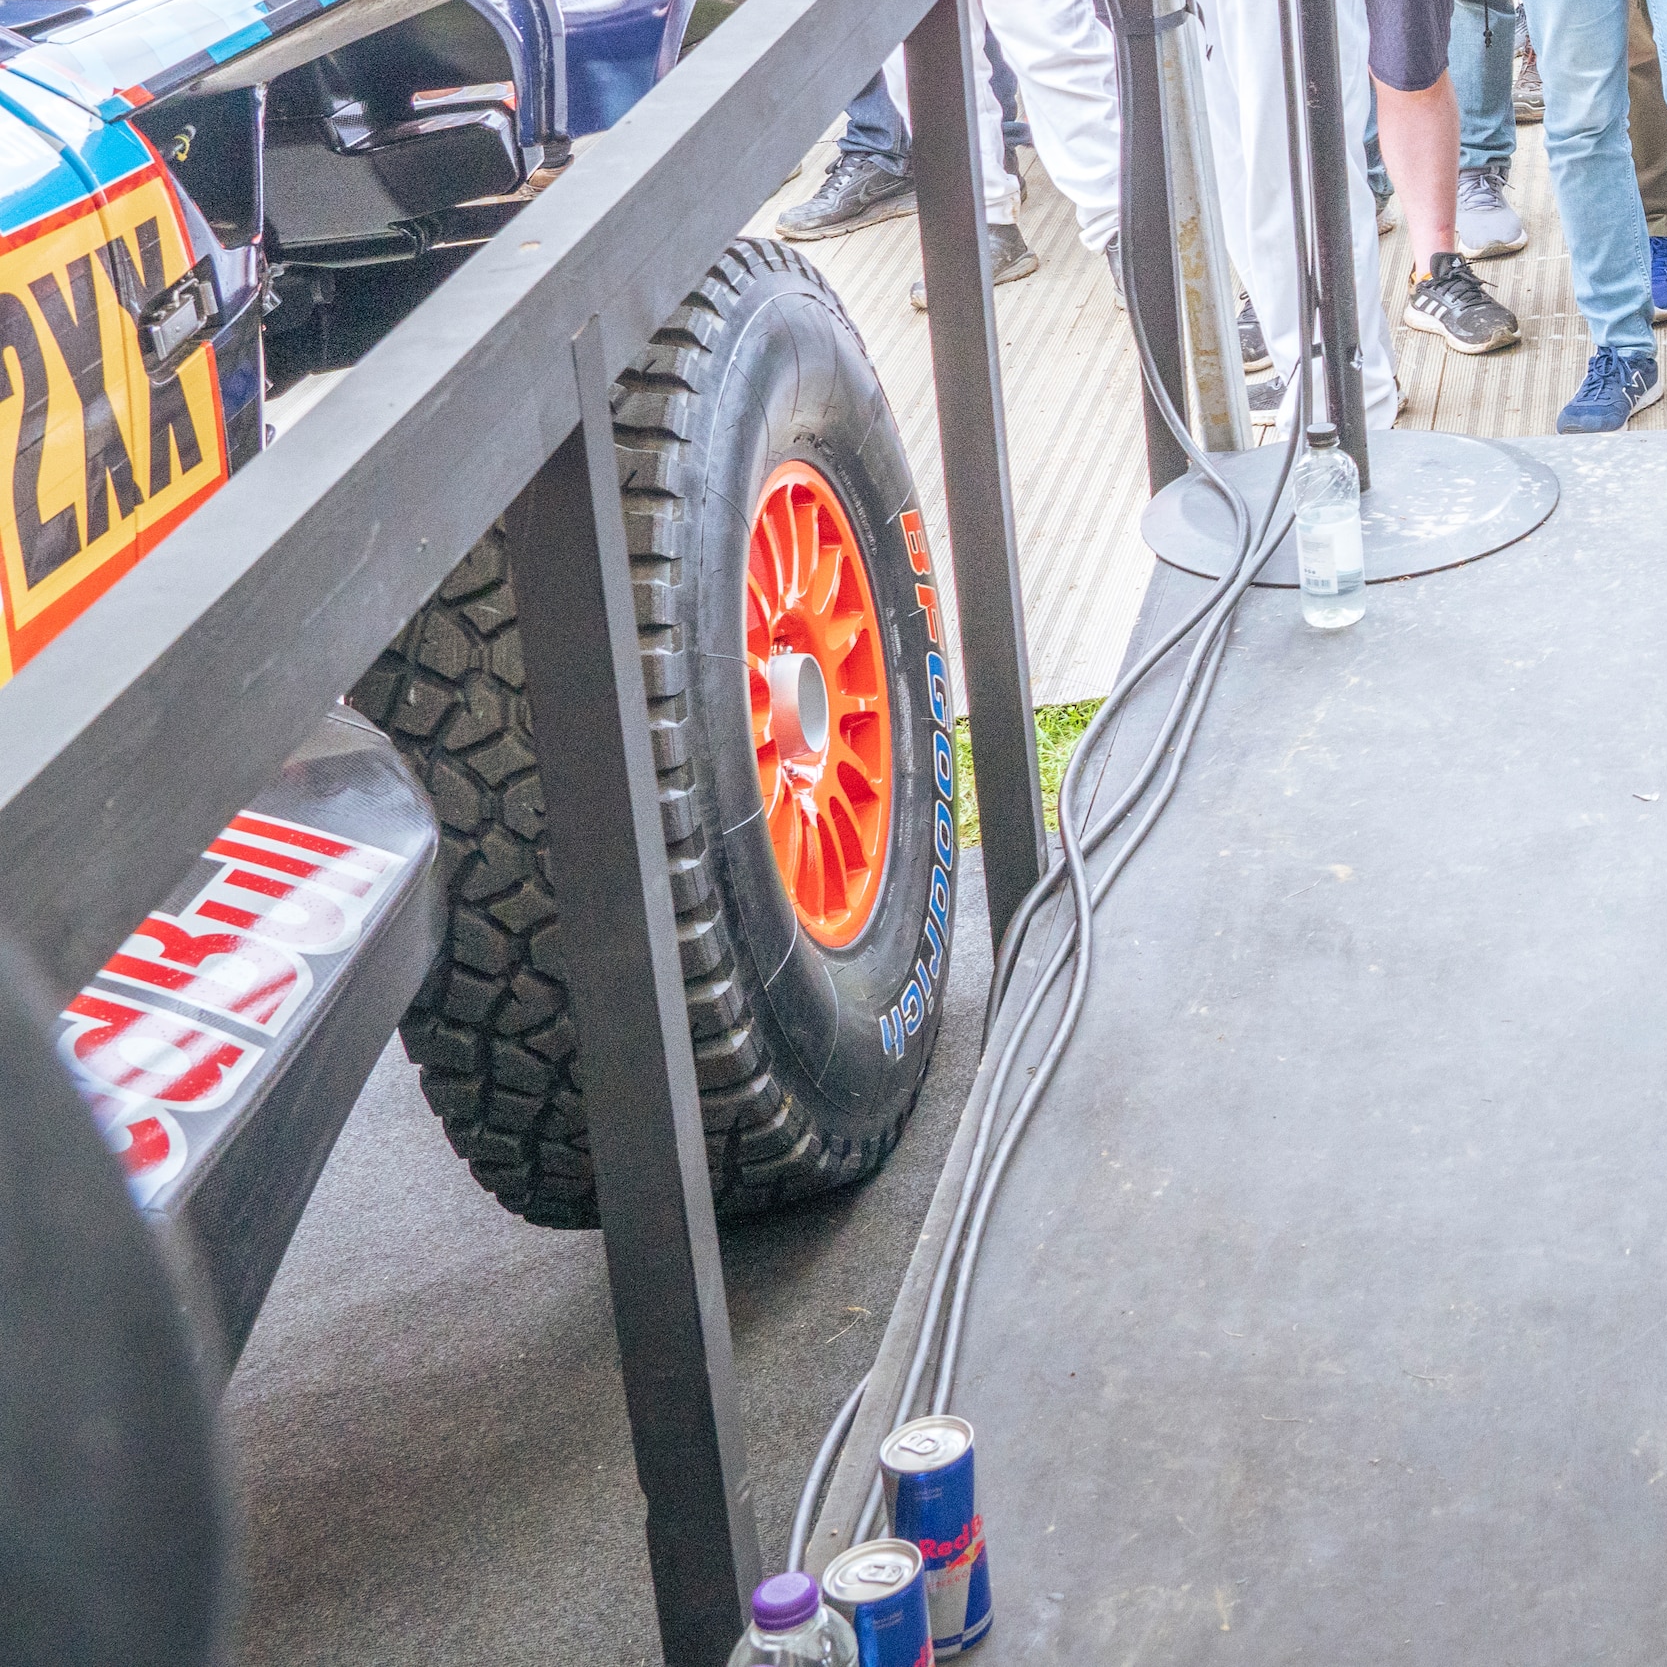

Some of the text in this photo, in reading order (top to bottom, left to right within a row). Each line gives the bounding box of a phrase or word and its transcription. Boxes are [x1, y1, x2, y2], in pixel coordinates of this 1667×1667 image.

[878, 508, 953, 1063] BFGoodrich
[97, 809, 409, 1038] Bull
[918, 1524, 970, 1561] Red
